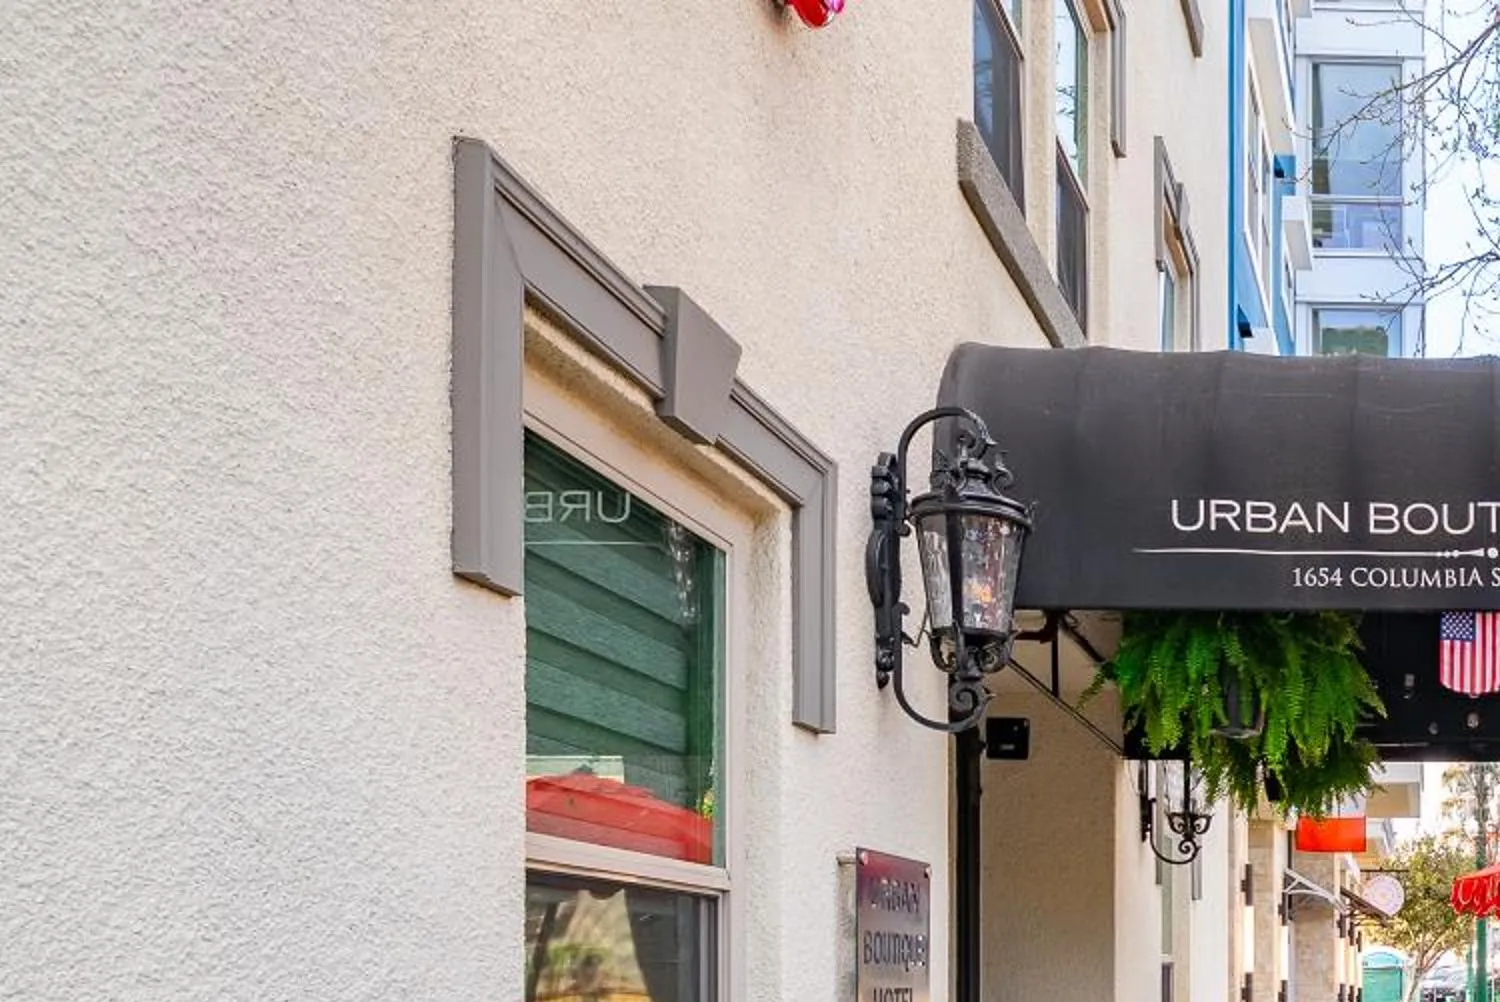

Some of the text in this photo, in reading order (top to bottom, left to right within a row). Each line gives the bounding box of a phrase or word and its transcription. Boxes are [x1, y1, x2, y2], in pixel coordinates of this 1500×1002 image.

[1171, 499, 1350, 534] URBAN
[1292, 567, 1343, 588] 1654
[1350, 566, 1485, 589] COLUMBIA
